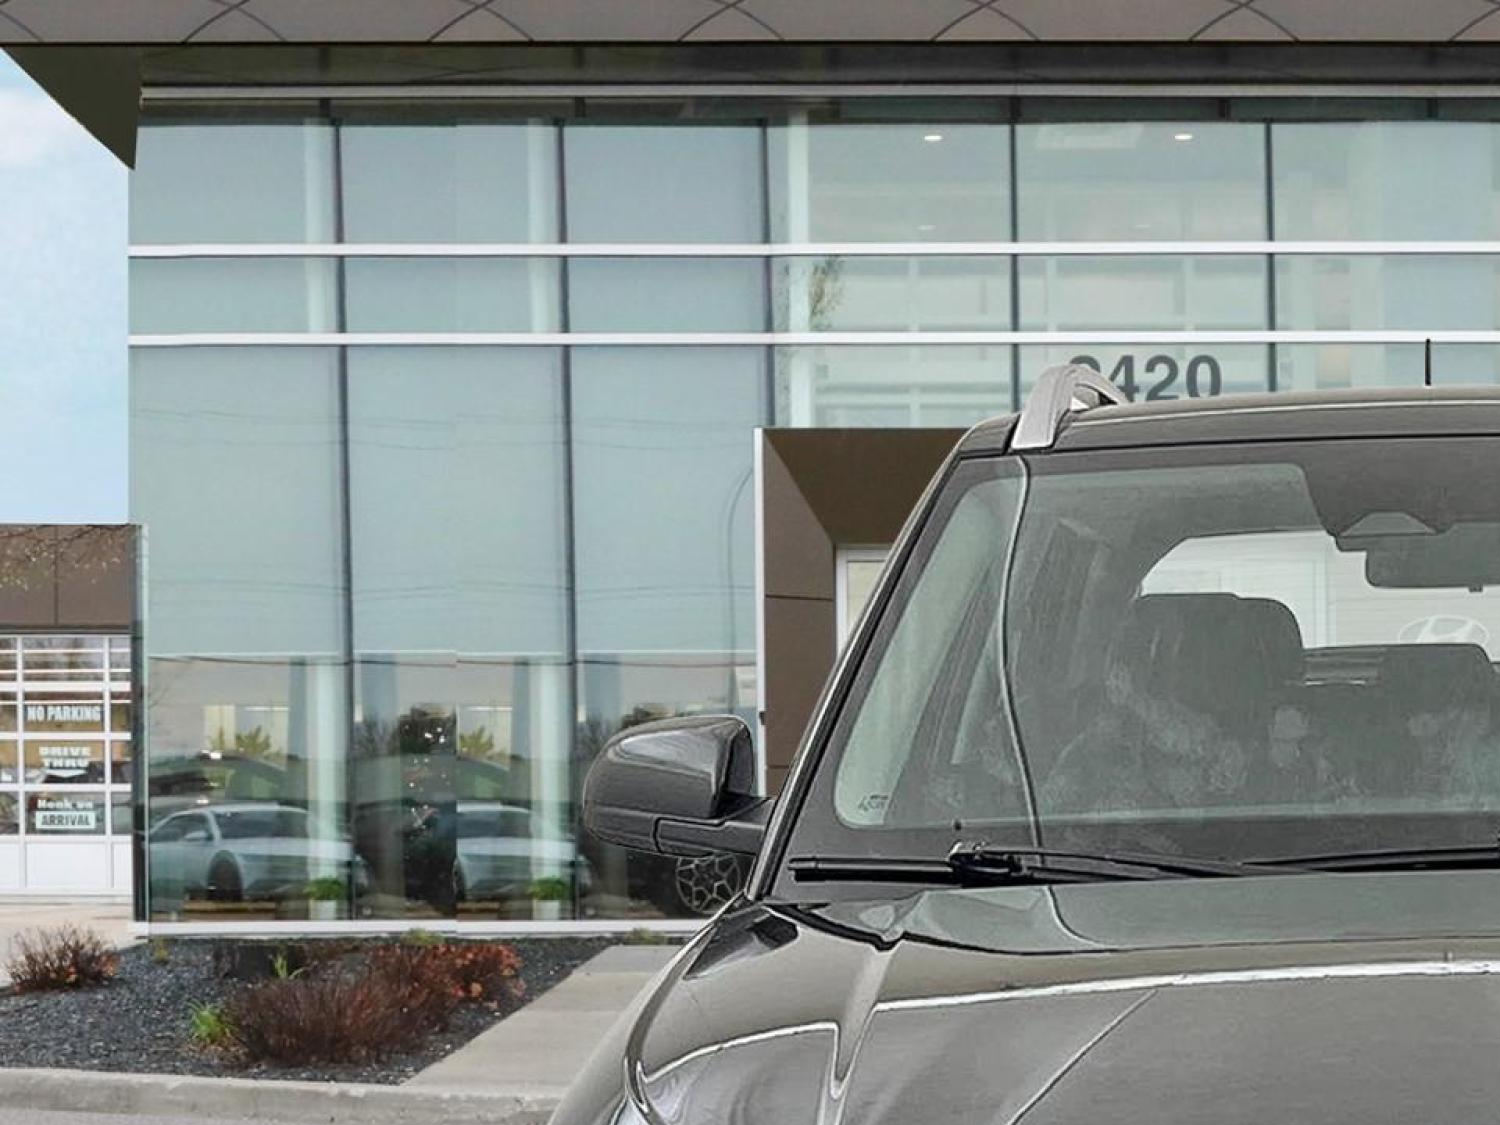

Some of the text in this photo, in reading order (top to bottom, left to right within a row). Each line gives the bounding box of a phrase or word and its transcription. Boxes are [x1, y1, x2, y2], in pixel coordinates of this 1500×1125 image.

[1070, 354, 1222, 402] 420
[27, 705, 101, 721] NO PARKING
[39, 746, 91, 756] DRIVE
[41, 813, 91, 826] ARRIVAL
